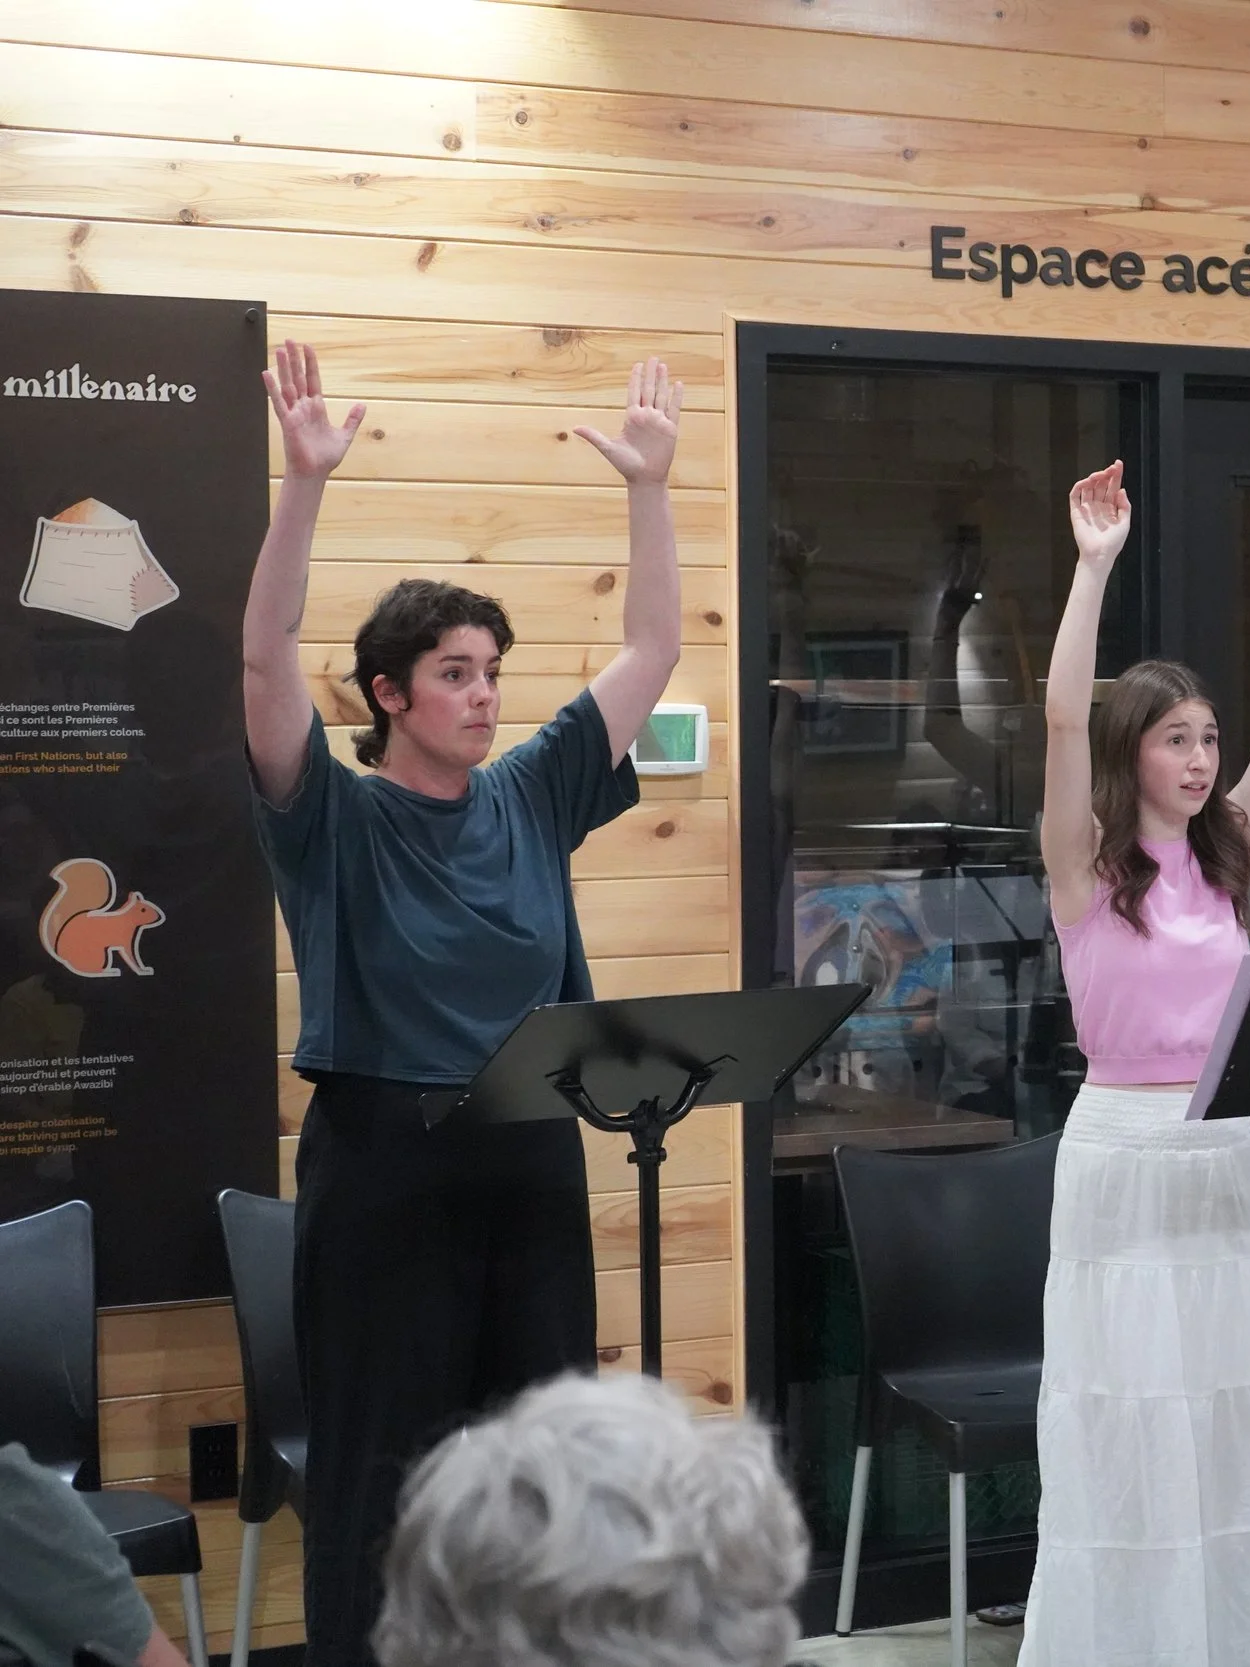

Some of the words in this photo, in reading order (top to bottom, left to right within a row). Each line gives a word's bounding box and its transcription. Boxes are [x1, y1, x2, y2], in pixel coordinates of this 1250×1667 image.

[931, 225, 1146, 298] Espace
[3, 363, 197, 403] millénaire
[0, 703, 49, 714] échanges
[52, 703, 79, 712] entre
[82, 702, 135, 712] Premières
[22, 715, 45, 724] sont
[47, 715, 62, 724] les
[65, 715, 118, 724] Premières
[1, 728, 38, 737] culture
[41, 729, 59, 737] aux
[62, 729, 107, 739] premiers
[110, 728, 146, 736] colons.
[15, 752, 38, 760] First
[41, 752, 83, 760] Nations,
[86, 751, 103, 760] but
[106, 751, 128, 760] also
[33, 765, 55, 773] who
[57, 764, 93, 773] shared
[96, 763, 120, 772] their
[0, 1058, 48, 1068] onisation
[51, 1057, 61, 1066] et
[64, 1056, 80, 1065] les
[82, 1054, 134, 1065] tentatives
[60, 1069, 71, 1078] et
[73, 1067, 116, 1079] peuvent
[1, 1084, 27, 1095] sirop
[29, 1081, 72, 1093] d'érable
[73, 1080, 113, 1090] Awazibi
[18, 1131, 58, 1142] thriving
[60, 1129, 80, 1139] and
[83, 1130, 101, 1138] can
